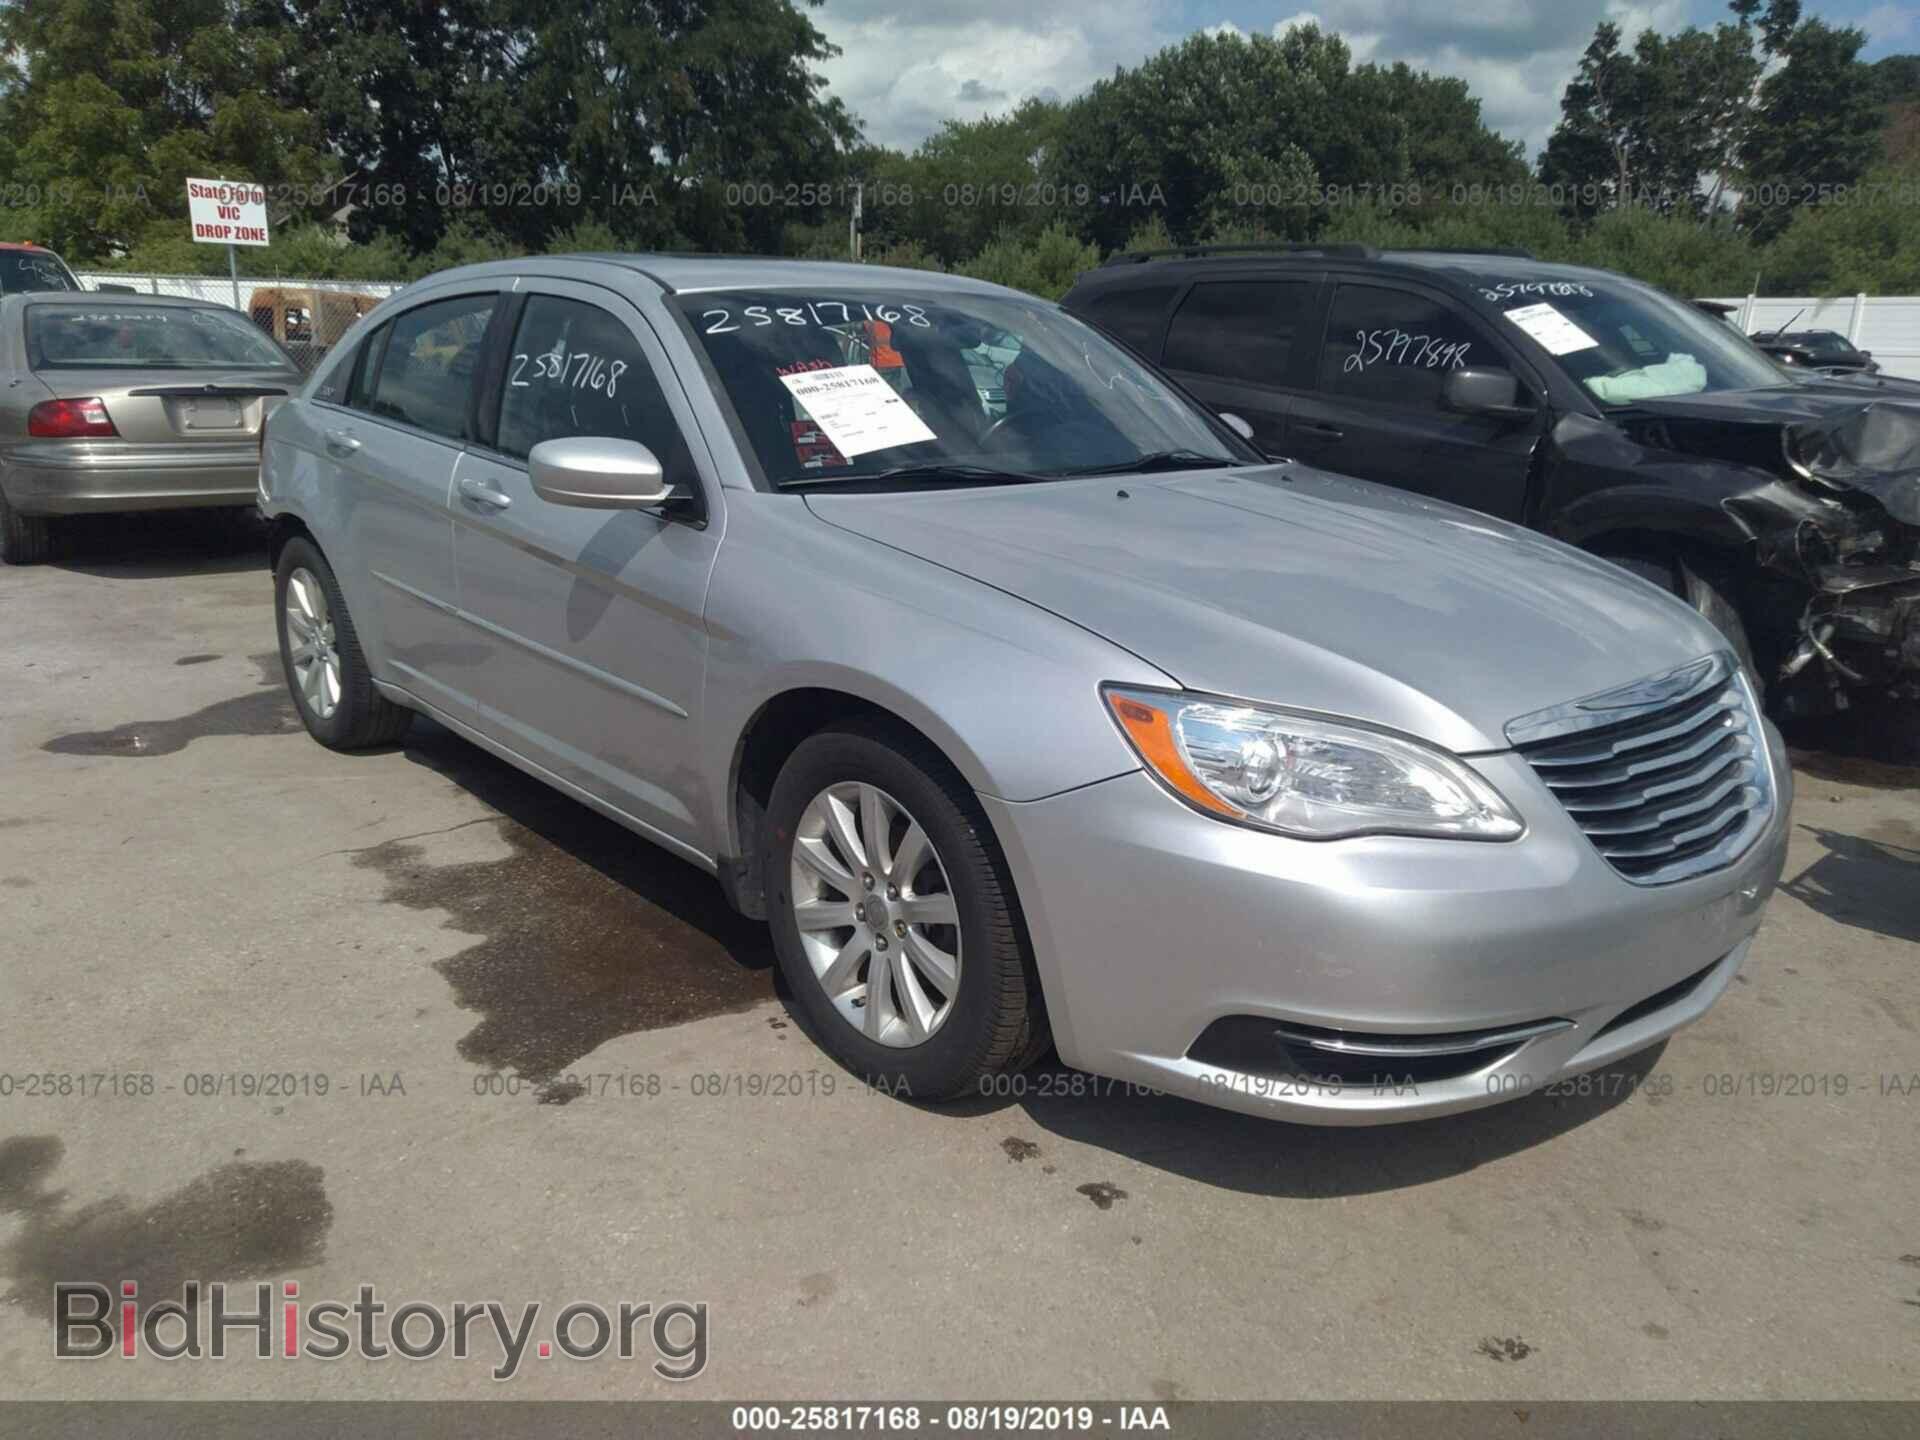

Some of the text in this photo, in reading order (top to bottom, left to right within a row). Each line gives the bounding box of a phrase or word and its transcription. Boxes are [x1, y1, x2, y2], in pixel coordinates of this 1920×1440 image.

[190, 183, 227, 200] State
[217, 205, 241, 220] VIC
[196, 223, 267, 241] DROP ZONE
[702, 302, 931, 335] 25817168
[511, 352, 629, 399] 25817168
